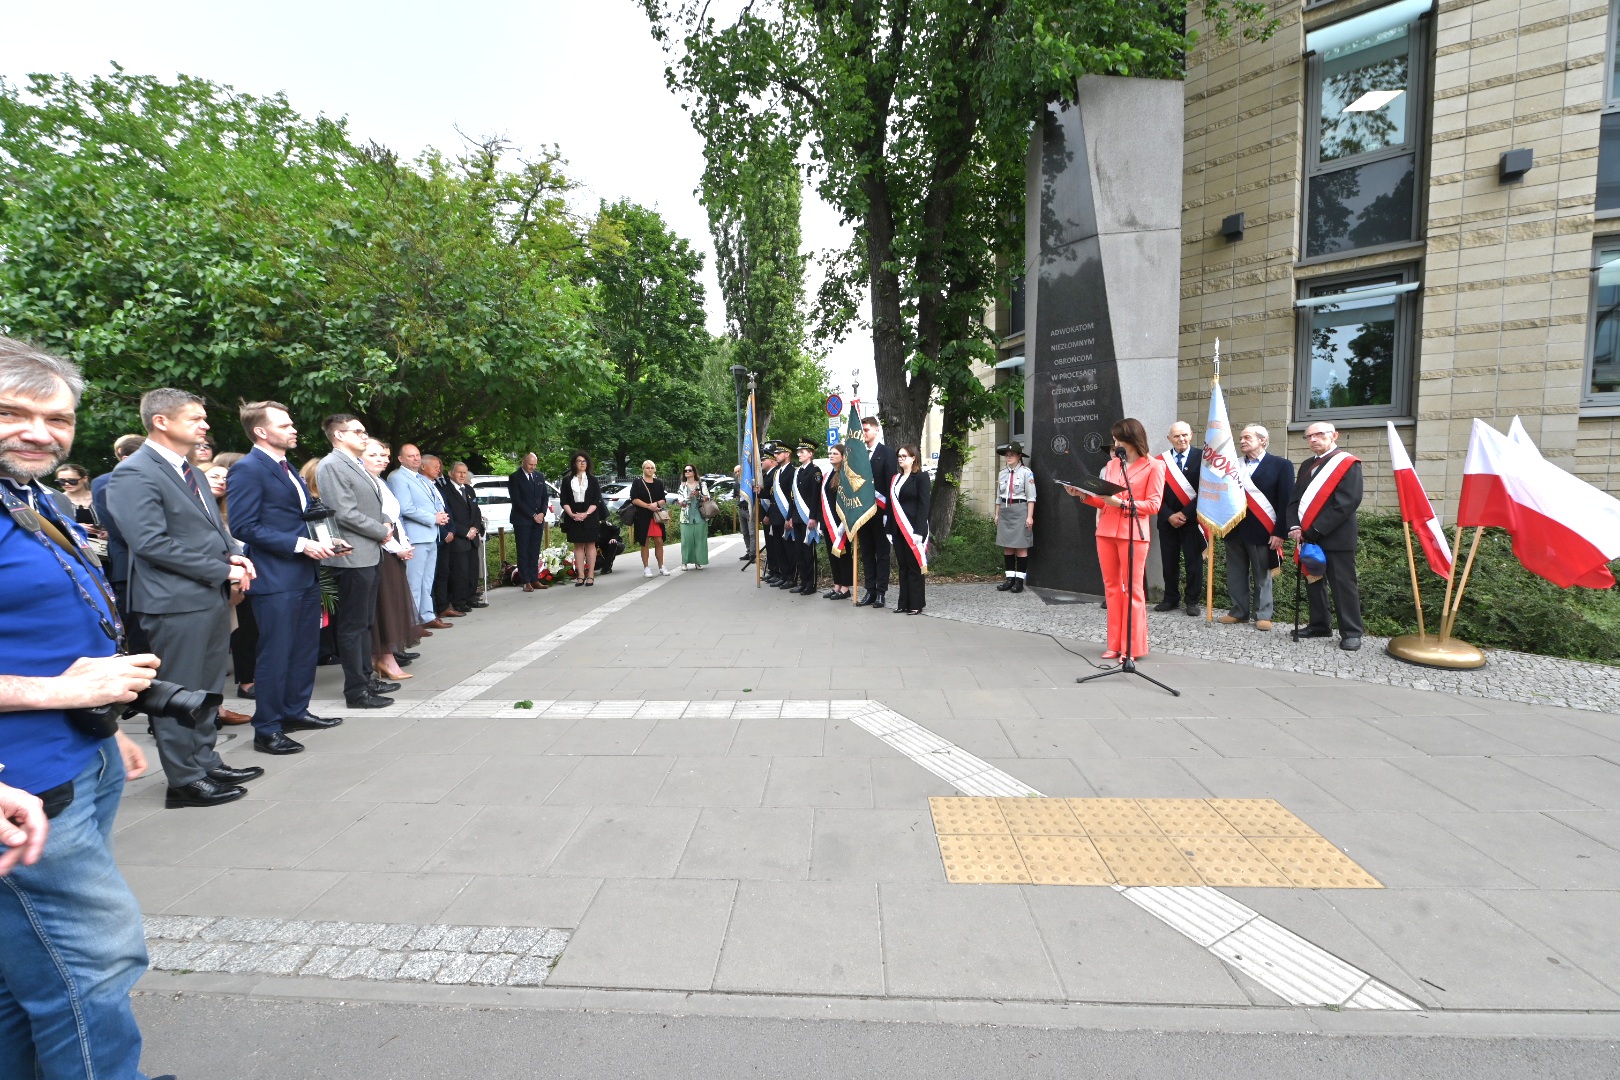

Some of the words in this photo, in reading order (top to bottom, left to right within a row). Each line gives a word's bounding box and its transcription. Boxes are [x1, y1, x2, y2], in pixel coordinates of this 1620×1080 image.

[1050, 322, 1095, 337] ADWOKATOM
[1050, 338, 1095, 351] NIEZŁOMNYM
[1053, 353, 1093, 366] OBROŃCOM
[1059, 368, 1097, 380] PROCESACH
[1051, 386, 1081, 396] CZERWCA
[1082, 383, 1098, 391] 1956
[1058, 398, 1096, 409] PROCESACH
[1053, 413, 1099, 424] POLITYCZNYCH
[829, 430, 837, 444] P
